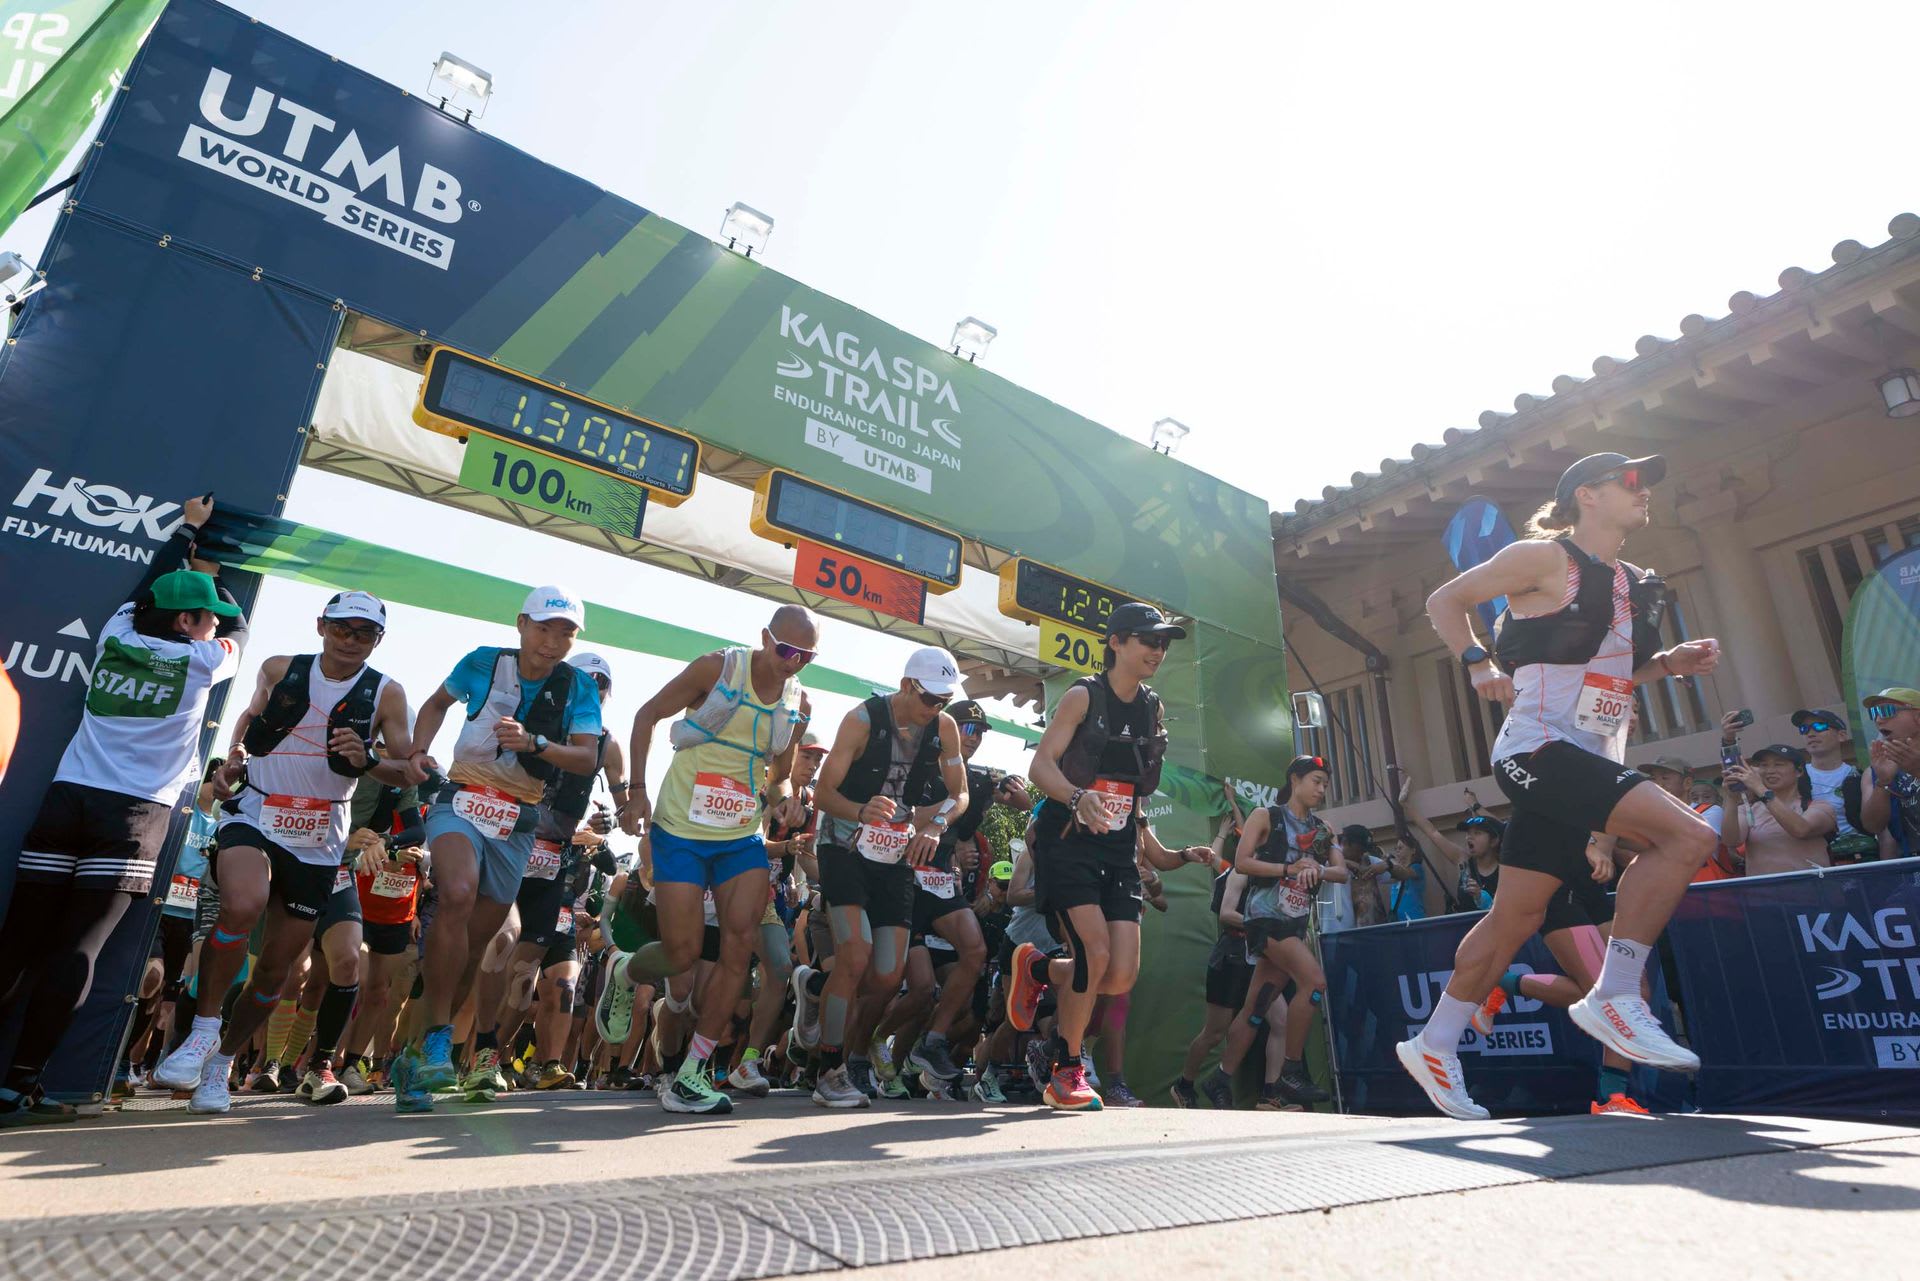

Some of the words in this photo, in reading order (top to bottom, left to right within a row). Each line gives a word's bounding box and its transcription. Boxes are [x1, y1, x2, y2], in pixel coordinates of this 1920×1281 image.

[199, 136, 331, 204] WORLD
[341, 204, 443, 258] SERIES
[818, 360, 929, 437] TRAIL
[774, 384, 878, 438] ENDURANCE
[880, 428, 906, 448] 100
[912, 442, 961, 472] JAPAN
[816, 427, 840, 448] BY
[864, 449, 917, 483] UTMB
[13, 468, 187, 543] HOK
[1, 517, 50, 538] FLY
[51, 528, 154, 565] HUMAN
[545, 599, 577, 611] HOKA
[3, 641, 93, 686] JUN
[94, 669, 175, 705] STAFF
[1592, 698, 1627, 717] 300
[464, 800, 505, 821] 3004
[704, 795, 743, 812] 3006
[707, 809, 725, 817] CHUN
[272, 815, 316, 831] 3008
[475, 815, 500, 828] CHEUNG
[273, 828, 311, 837] SHUNSUKE
[866, 831, 899, 848] 3003
[528, 854, 551, 867] 007
[382, 877, 408, 888] 3060
[922, 876, 945, 887] 3005
[1797, 908, 1919, 952] KAG
[1601, 1002, 1637, 1040] TERREX
[1487, 1029, 1546, 1050] SERIES
